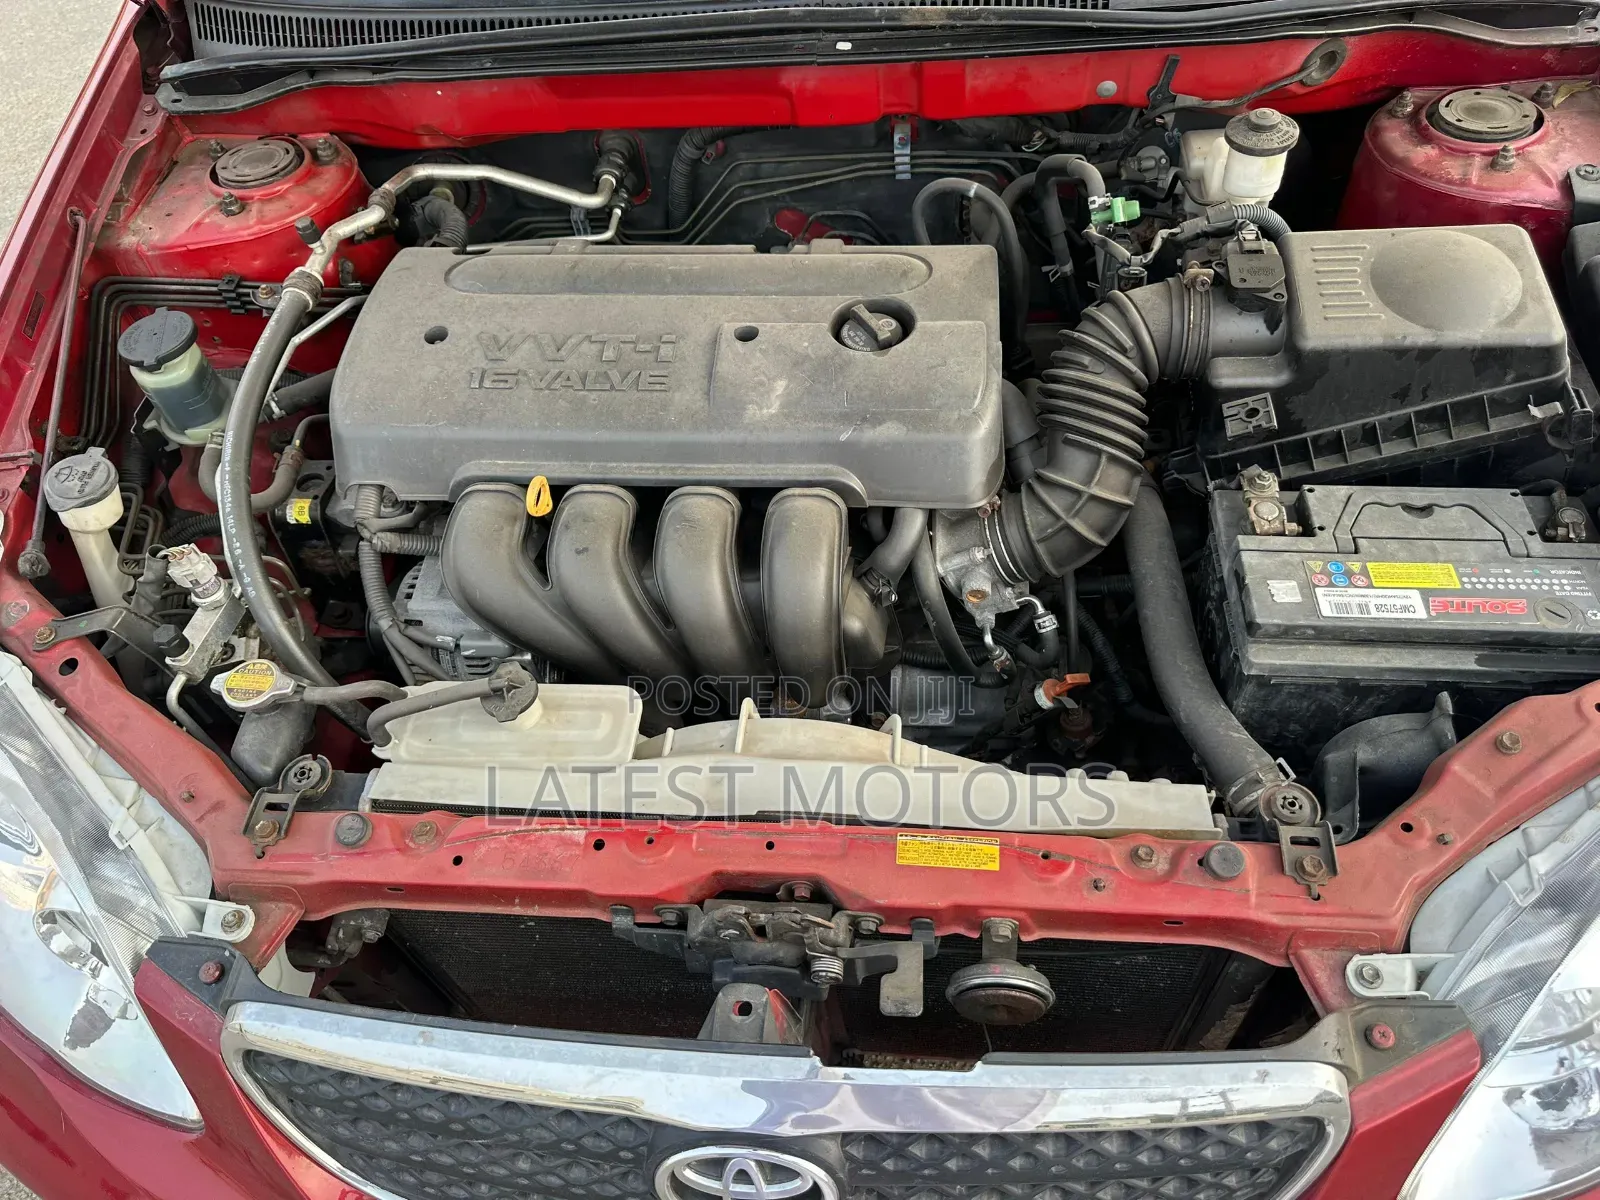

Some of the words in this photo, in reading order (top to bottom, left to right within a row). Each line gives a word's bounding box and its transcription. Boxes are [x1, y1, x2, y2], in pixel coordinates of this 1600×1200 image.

[477, 331, 677, 363] VVT-i
[469, 367, 519, 390] 16
[521, 368, 669, 392] VALVE
[1374, 603, 1417, 614] CMF57528
[1429, 597, 1528, 614] SOLITE
[238, 668, 272, 676] CAUTION
